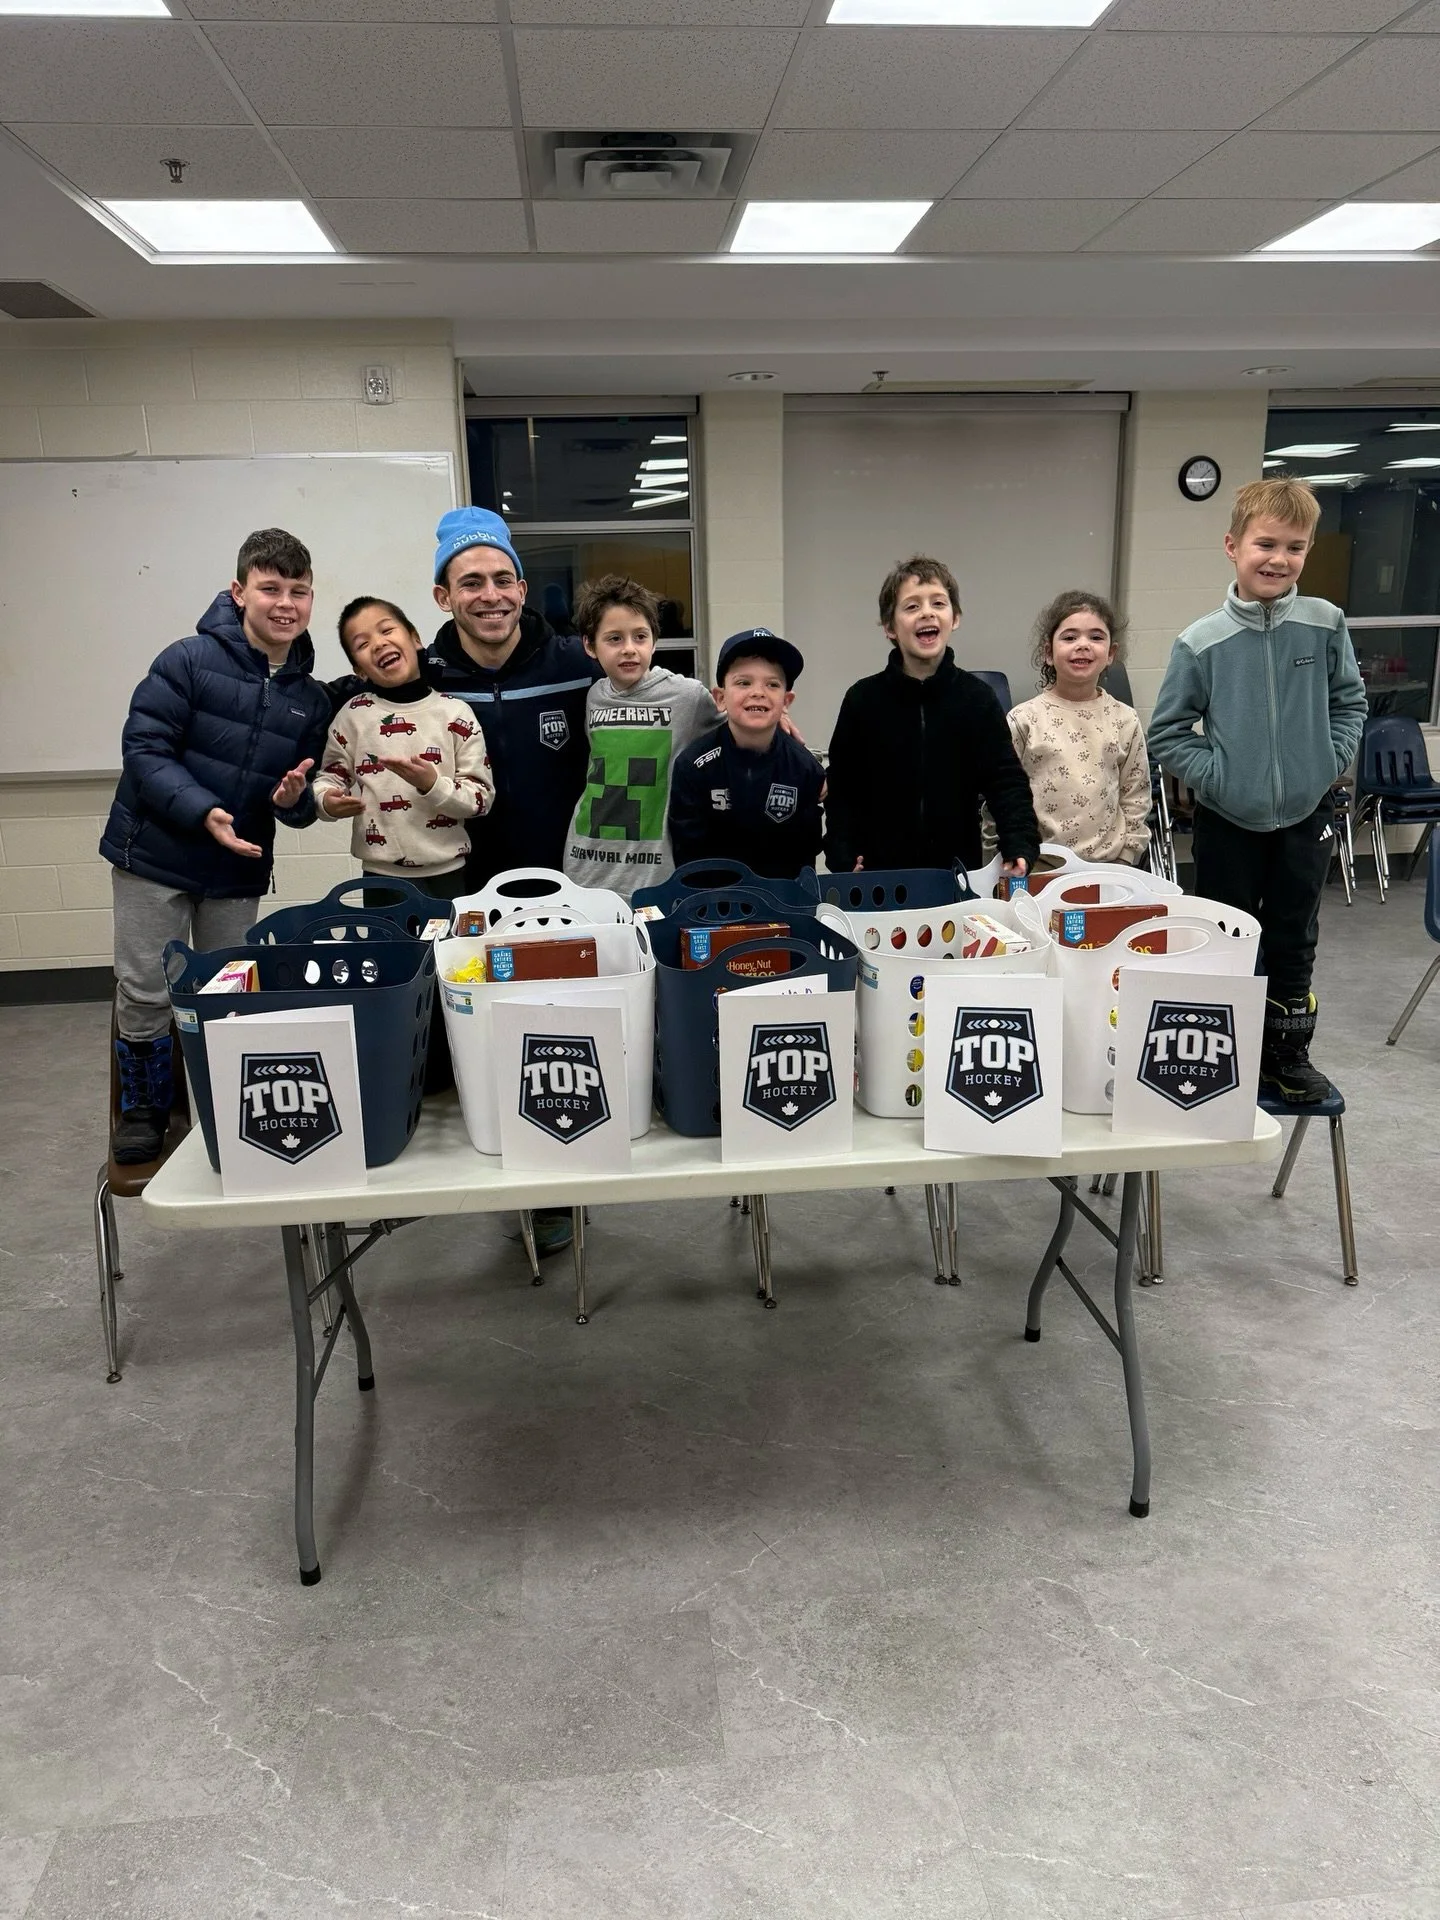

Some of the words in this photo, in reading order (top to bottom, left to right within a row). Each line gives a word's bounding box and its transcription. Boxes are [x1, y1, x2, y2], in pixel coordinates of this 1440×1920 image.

[588, 707, 672, 728] MINECRAFT
[542, 720, 566, 735] TOP
[769, 794, 795, 808] TOP
[570, 845, 622, 864] SURVIVAL
[625, 852, 662, 865] MODE
[728, 961, 755, 971] Honey
[756, 960, 771, 969] Nut
[953, 1034, 1035, 1073] TOP
[1147, 1028, 1233, 1066] TOP
[750, 1048, 829, 1088] TOP
[1158, 1064, 1219, 1078] HOCKEY
[523, 1060, 600, 1098] TOP
[965, 1074, 1022, 1088] HOCKEY
[242, 1079, 329, 1119] TOP
[762, 1085, 818, 1100] HOCKEY
[536, 1098, 591, 1111] HOCKEY
[258, 1117, 319, 1132] HOCKEY
